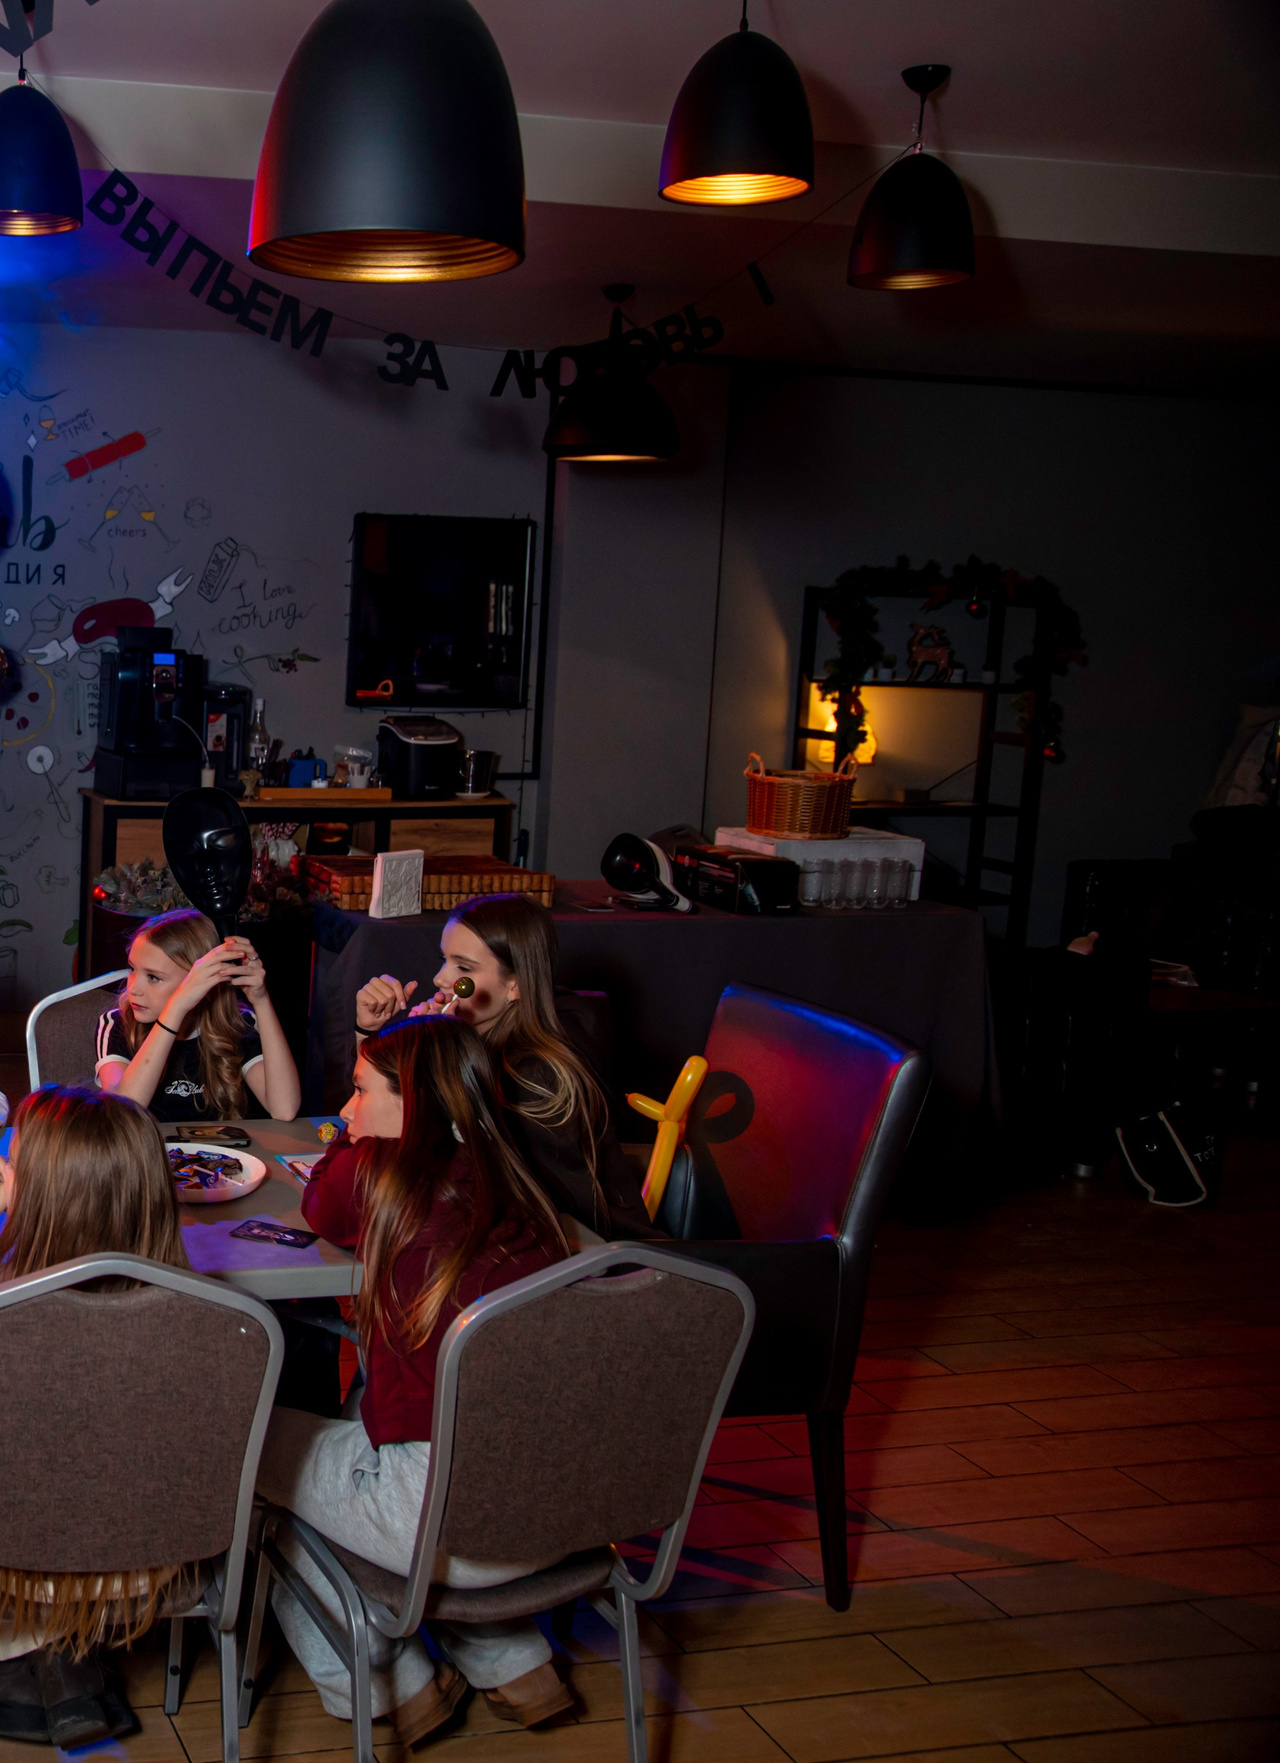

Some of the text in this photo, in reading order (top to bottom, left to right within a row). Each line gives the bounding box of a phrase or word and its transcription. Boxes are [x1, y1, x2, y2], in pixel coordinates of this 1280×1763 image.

[85, 168, 333, 357] ВЫПЬЕМ
[377, 332, 448, 391] ЗА
[107, 524, 147, 538] cheers
[199, 553, 227, 596] MILK
[230, 579, 254, 610] I
